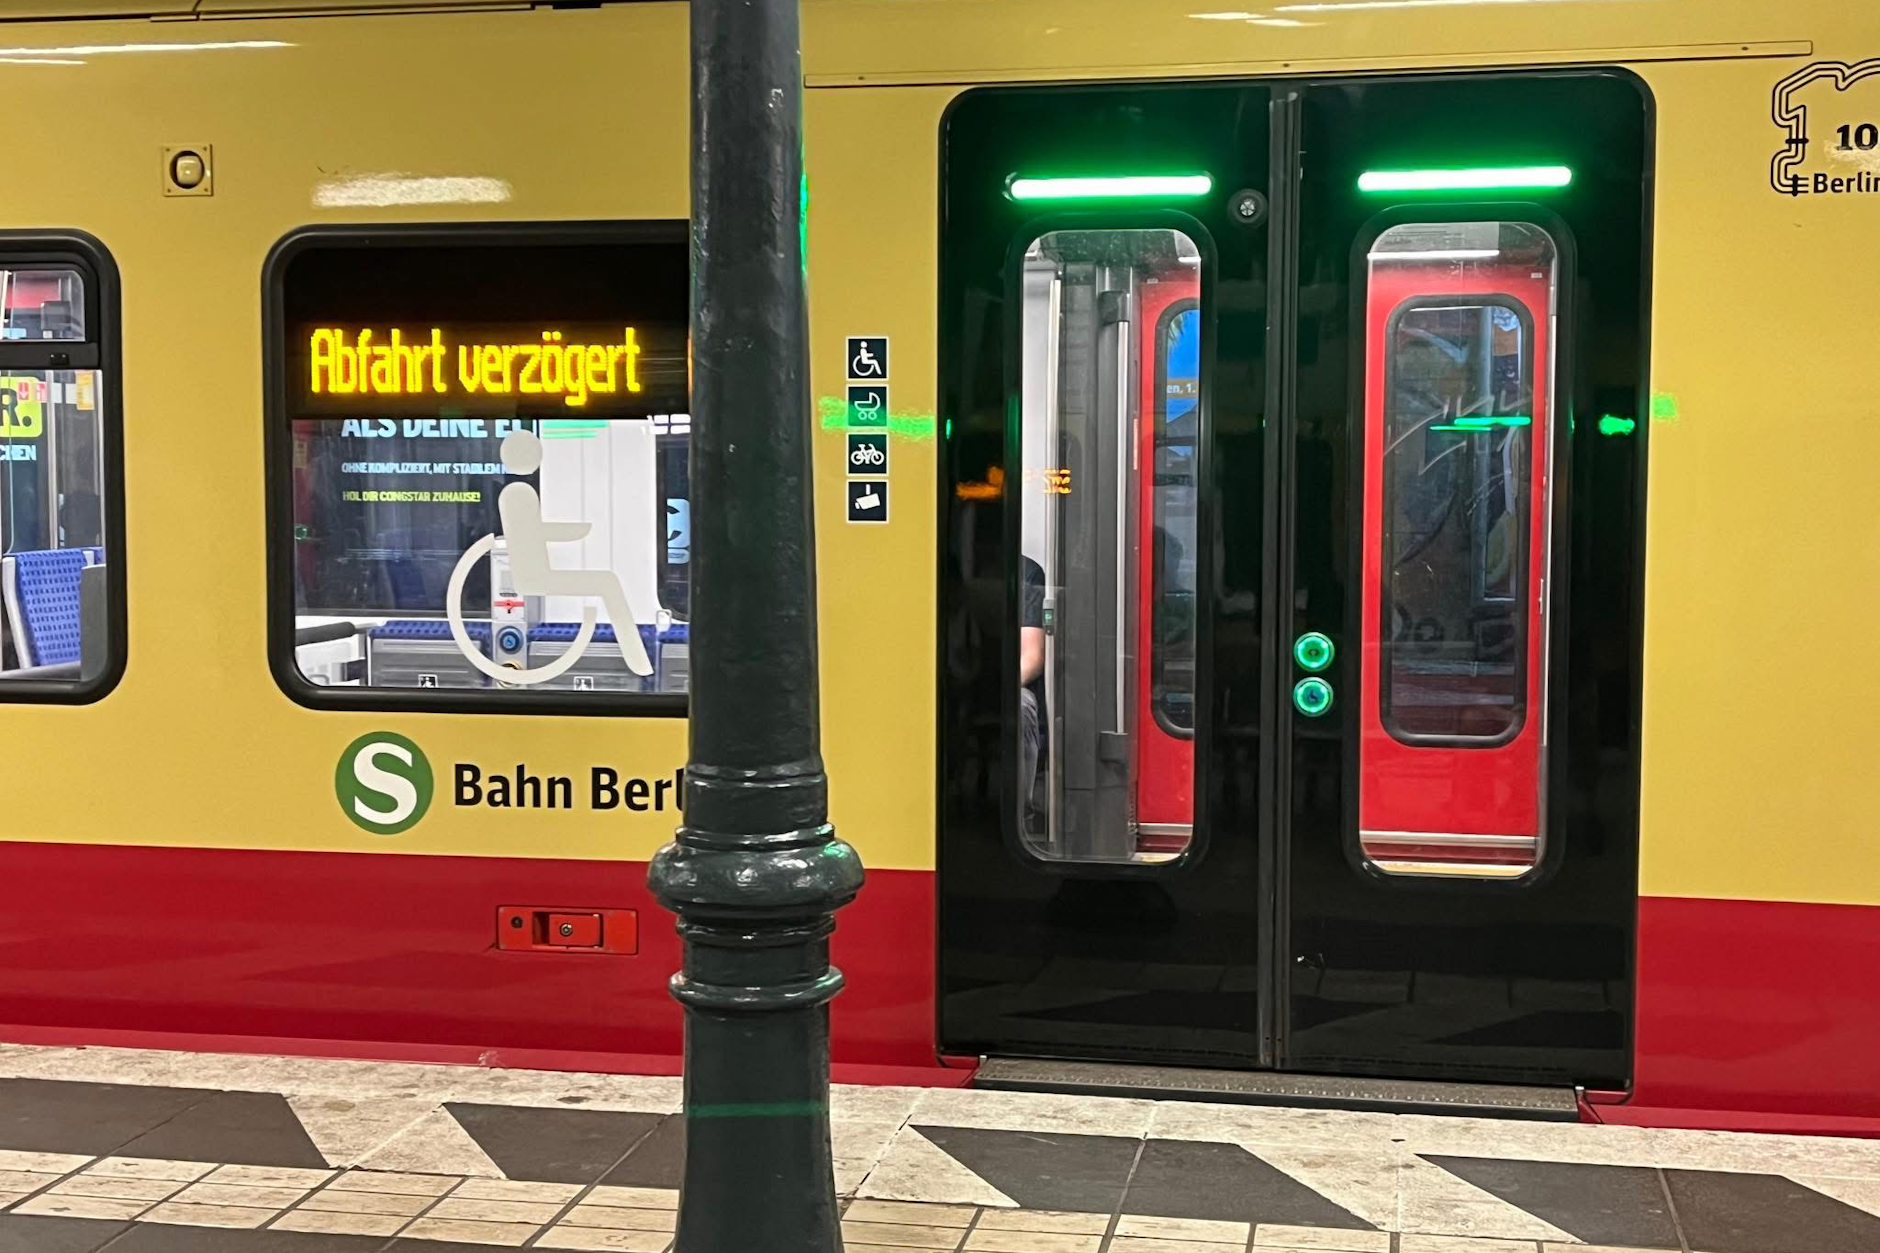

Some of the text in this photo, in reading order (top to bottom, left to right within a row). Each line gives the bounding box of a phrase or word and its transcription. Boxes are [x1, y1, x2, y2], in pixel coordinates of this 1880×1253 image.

[311, 327, 641, 406] Abfahrt verzögert
[341, 418, 397, 438] ALS
[403, 418, 488, 438] DEINE
[341, 462, 368, 474] OHNE
[433, 463, 450, 474] MIT
[342, 491, 362, 502] HOL
[353, 742, 417, 825] S
[454, 763, 572, 809] Bahn
